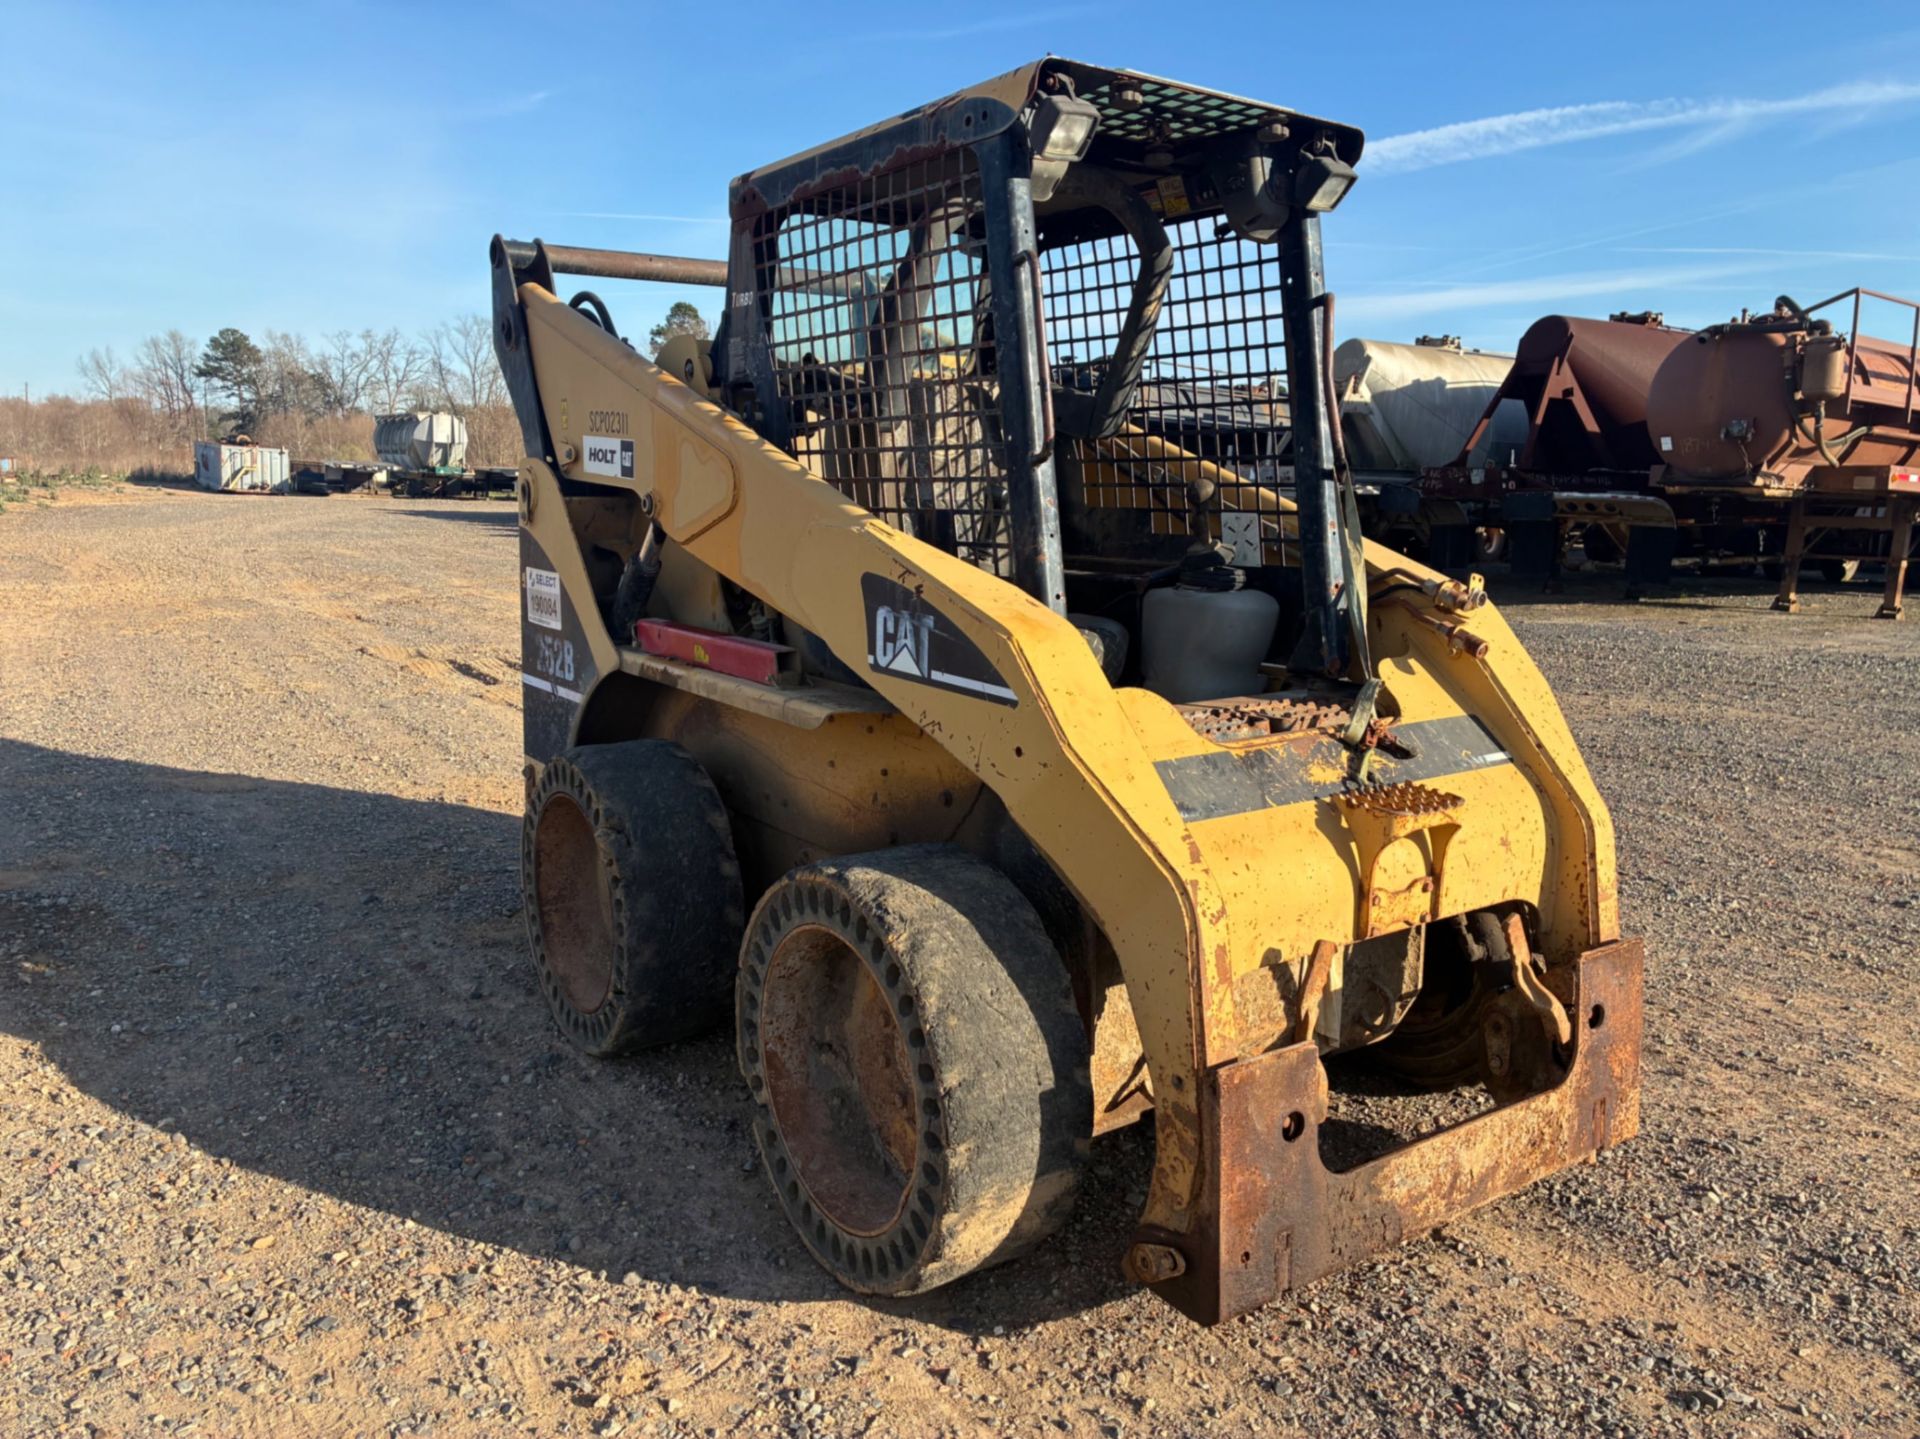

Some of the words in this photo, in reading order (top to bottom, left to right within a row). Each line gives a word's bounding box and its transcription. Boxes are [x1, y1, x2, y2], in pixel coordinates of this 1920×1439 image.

[588, 410, 629, 435] SCP02311
[588, 447, 617, 465] HOLT
[876, 605, 934, 679] CAT
